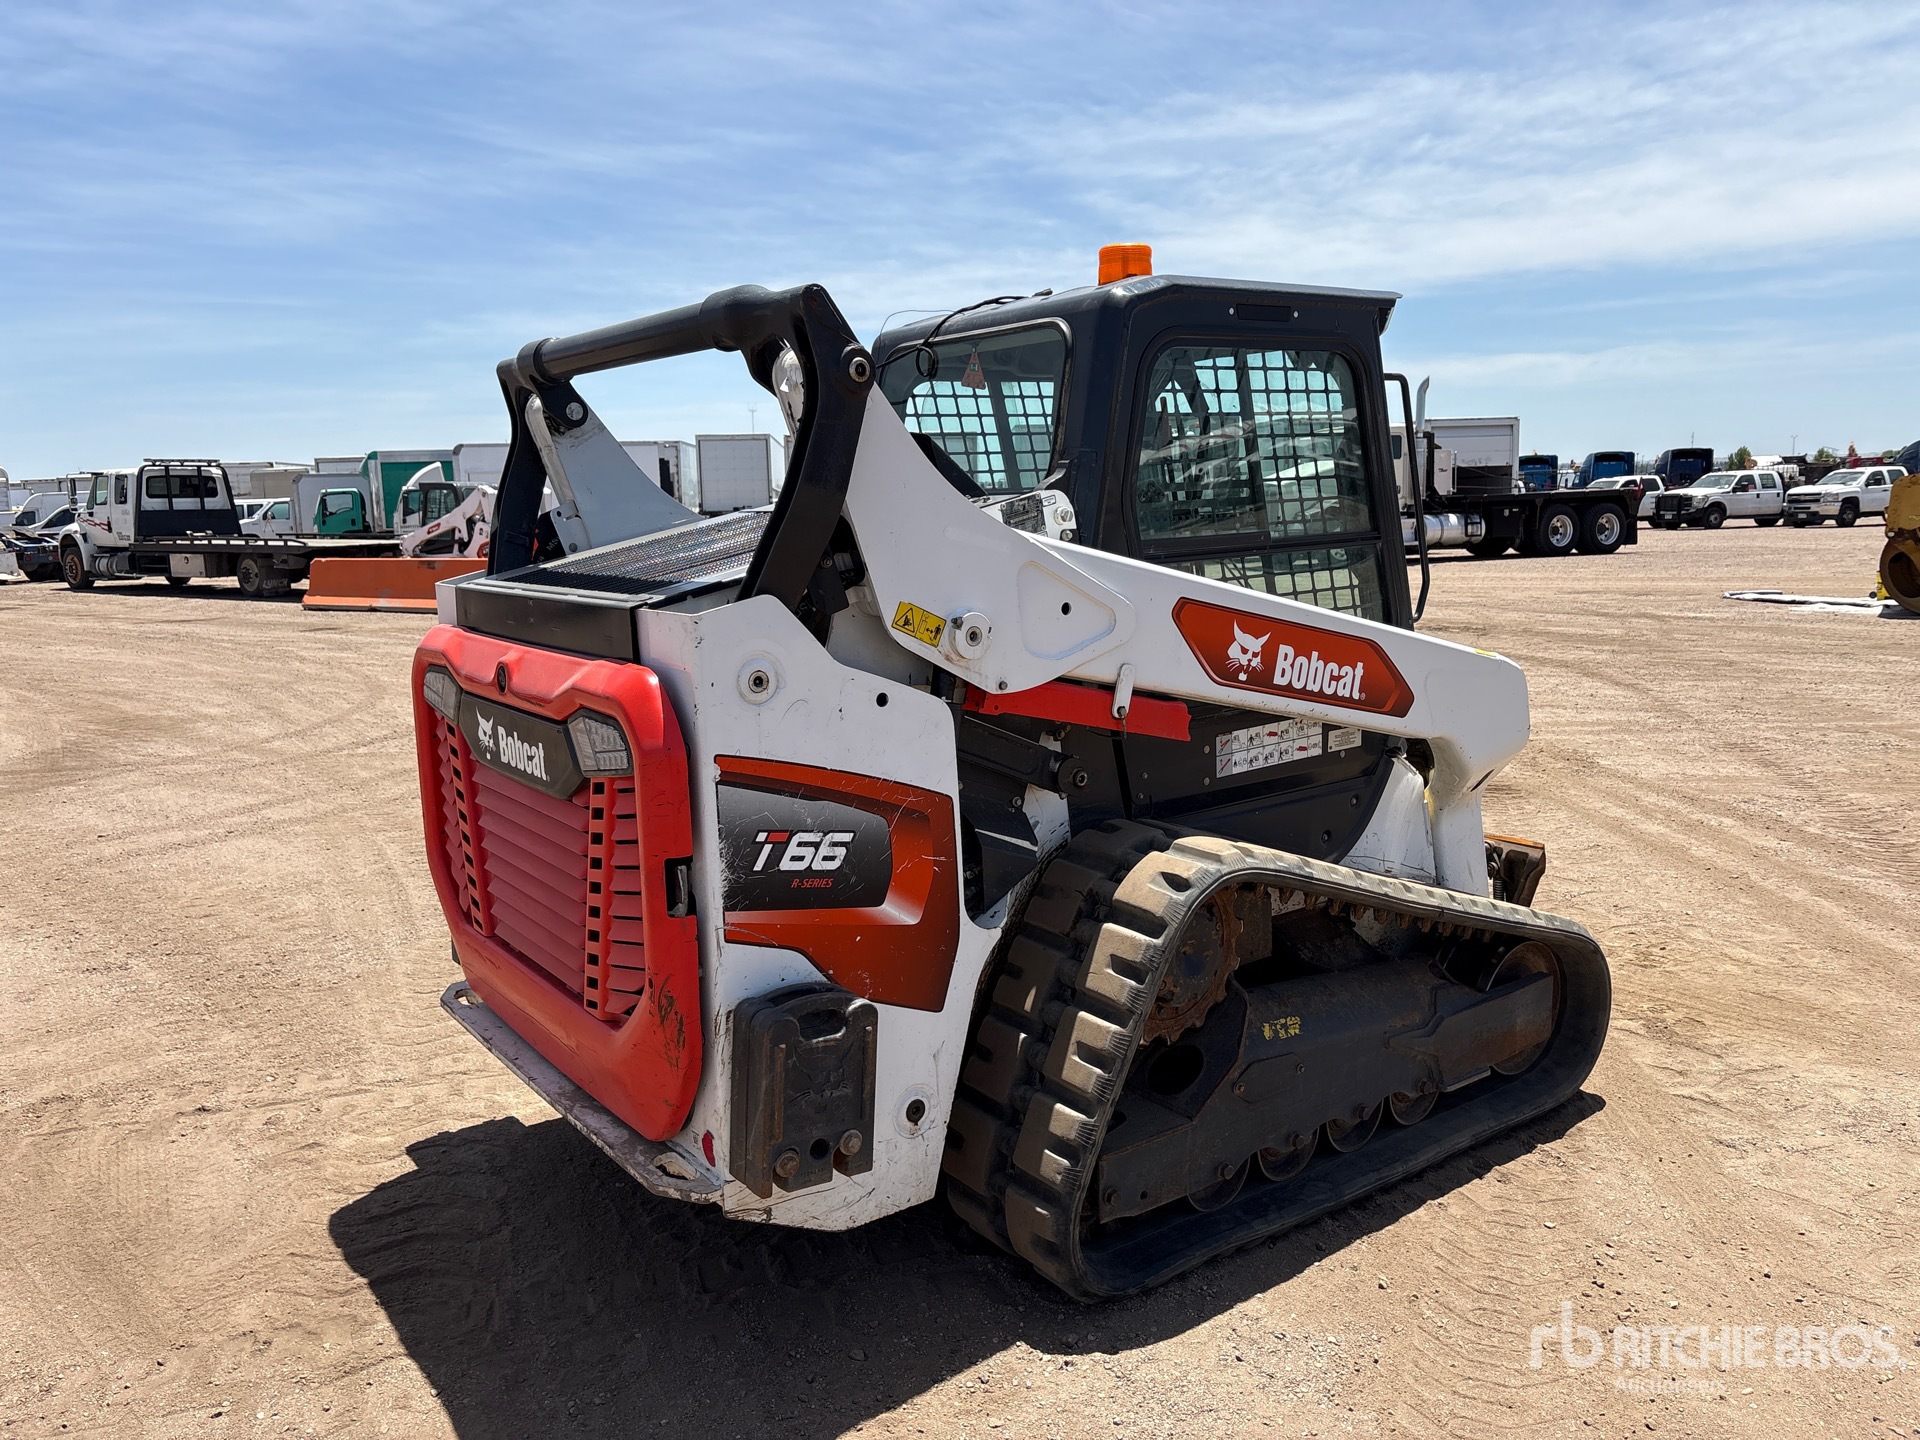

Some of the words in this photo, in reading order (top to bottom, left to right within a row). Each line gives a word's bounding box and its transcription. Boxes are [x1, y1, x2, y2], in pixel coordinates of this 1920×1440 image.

[1273, 643, 1364, 700] Bobcat
[498, 725, 547, 781] Bobcat
[752, 831, 855, 871] T66
[790, 878, 833, 888] R-SERIES
